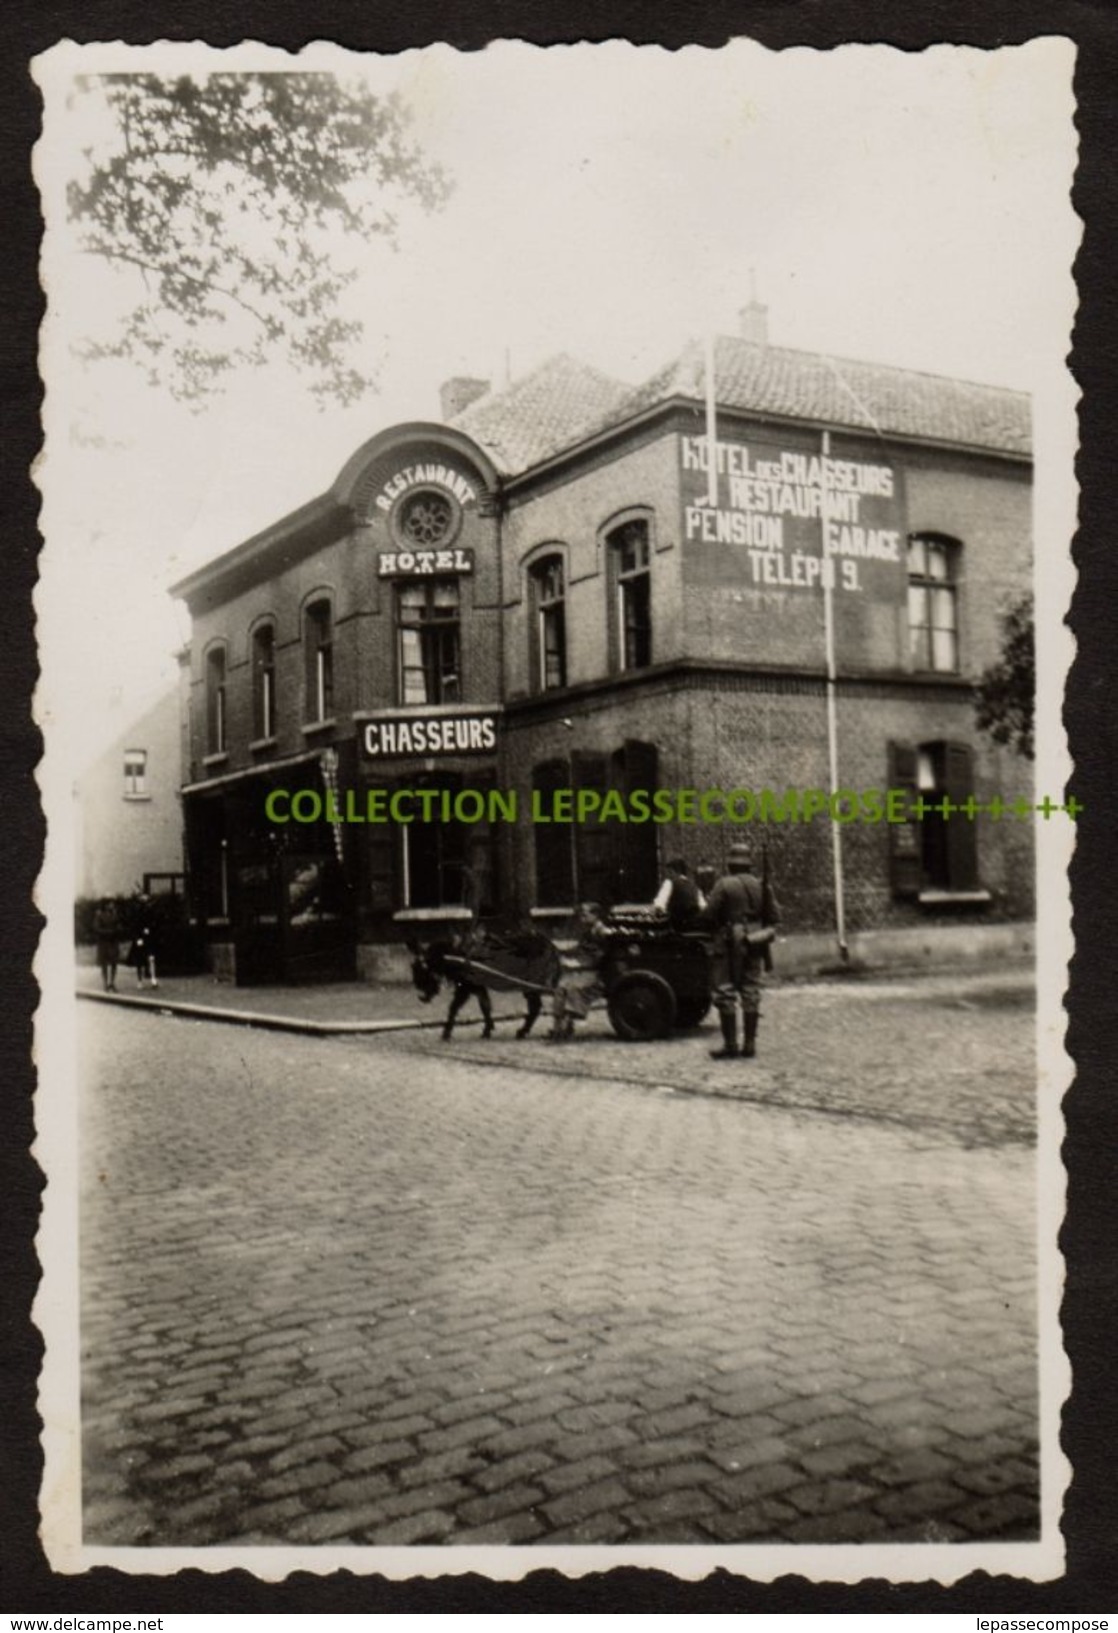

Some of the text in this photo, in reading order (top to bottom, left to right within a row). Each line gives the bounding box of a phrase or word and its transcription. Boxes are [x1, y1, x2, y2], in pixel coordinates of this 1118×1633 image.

[376, 464, 476, 511] RESTAURANT
[781, 452, 894, 497] CHASSEURS
[729, 477, 860, 523] RESTAURANT
[685, 505, 900, 562] PENSION GARAGE
[379, 550, 471, 574] HOTEL
[365, 718, 496, 754] CHASSEURS
